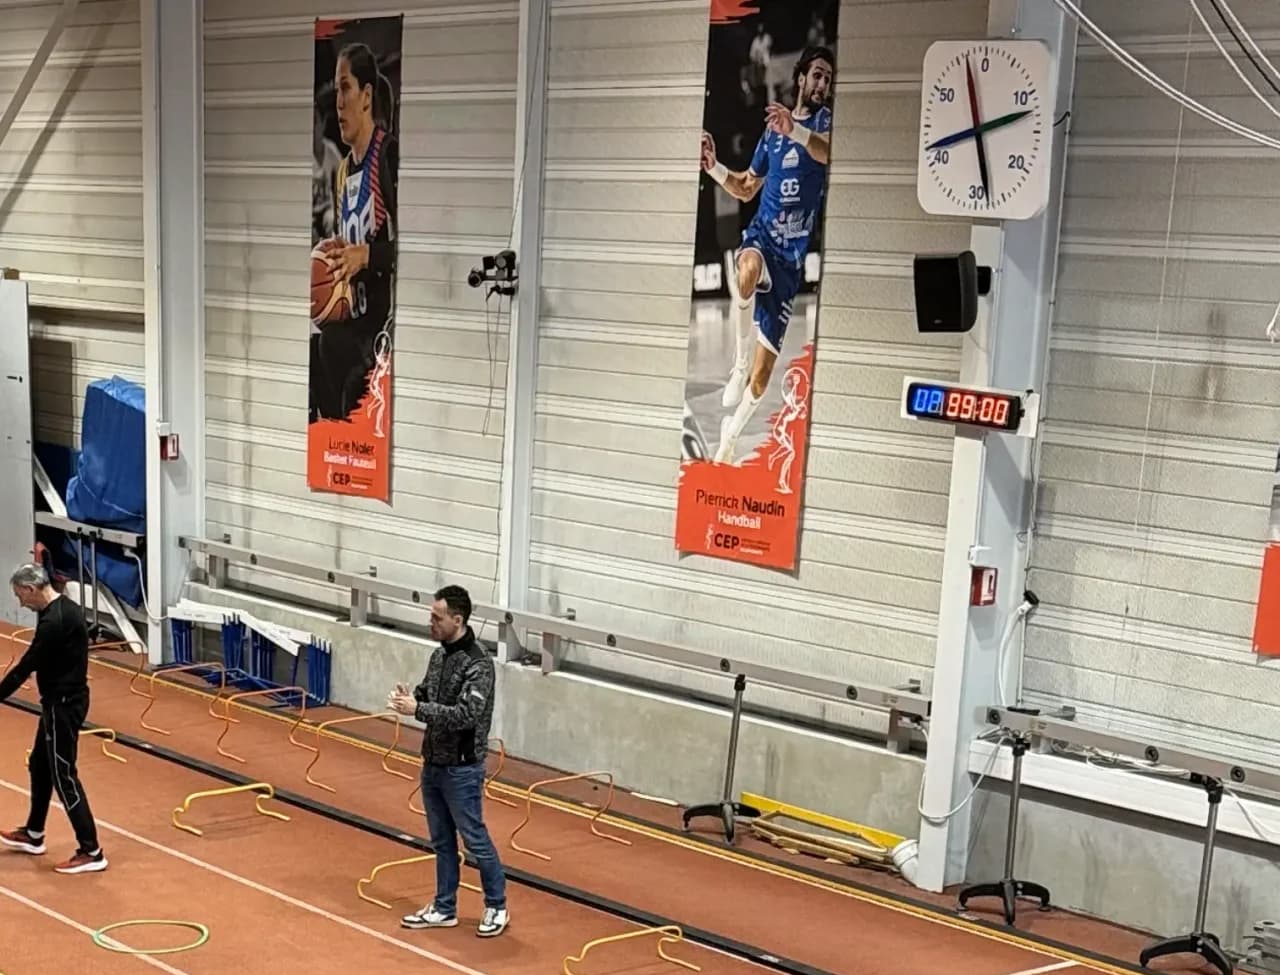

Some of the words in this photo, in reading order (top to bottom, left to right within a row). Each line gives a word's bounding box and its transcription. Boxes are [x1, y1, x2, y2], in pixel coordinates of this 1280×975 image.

[939, 88, 955, 103] 50
[1013, 91, 1029, 106] 10
[934, 149, 949, 165] 40
[1008, 155, 1025, 170] 20
[969, 185, 985, 200] 30
[332, 471, 351, 486] CEP
[696, 489, 738, 509] Pierrick
[742, 496, 785, 517] Naudin
[718, 511, 761, 529] Handball
[714, 533, 739, 549] CEP
